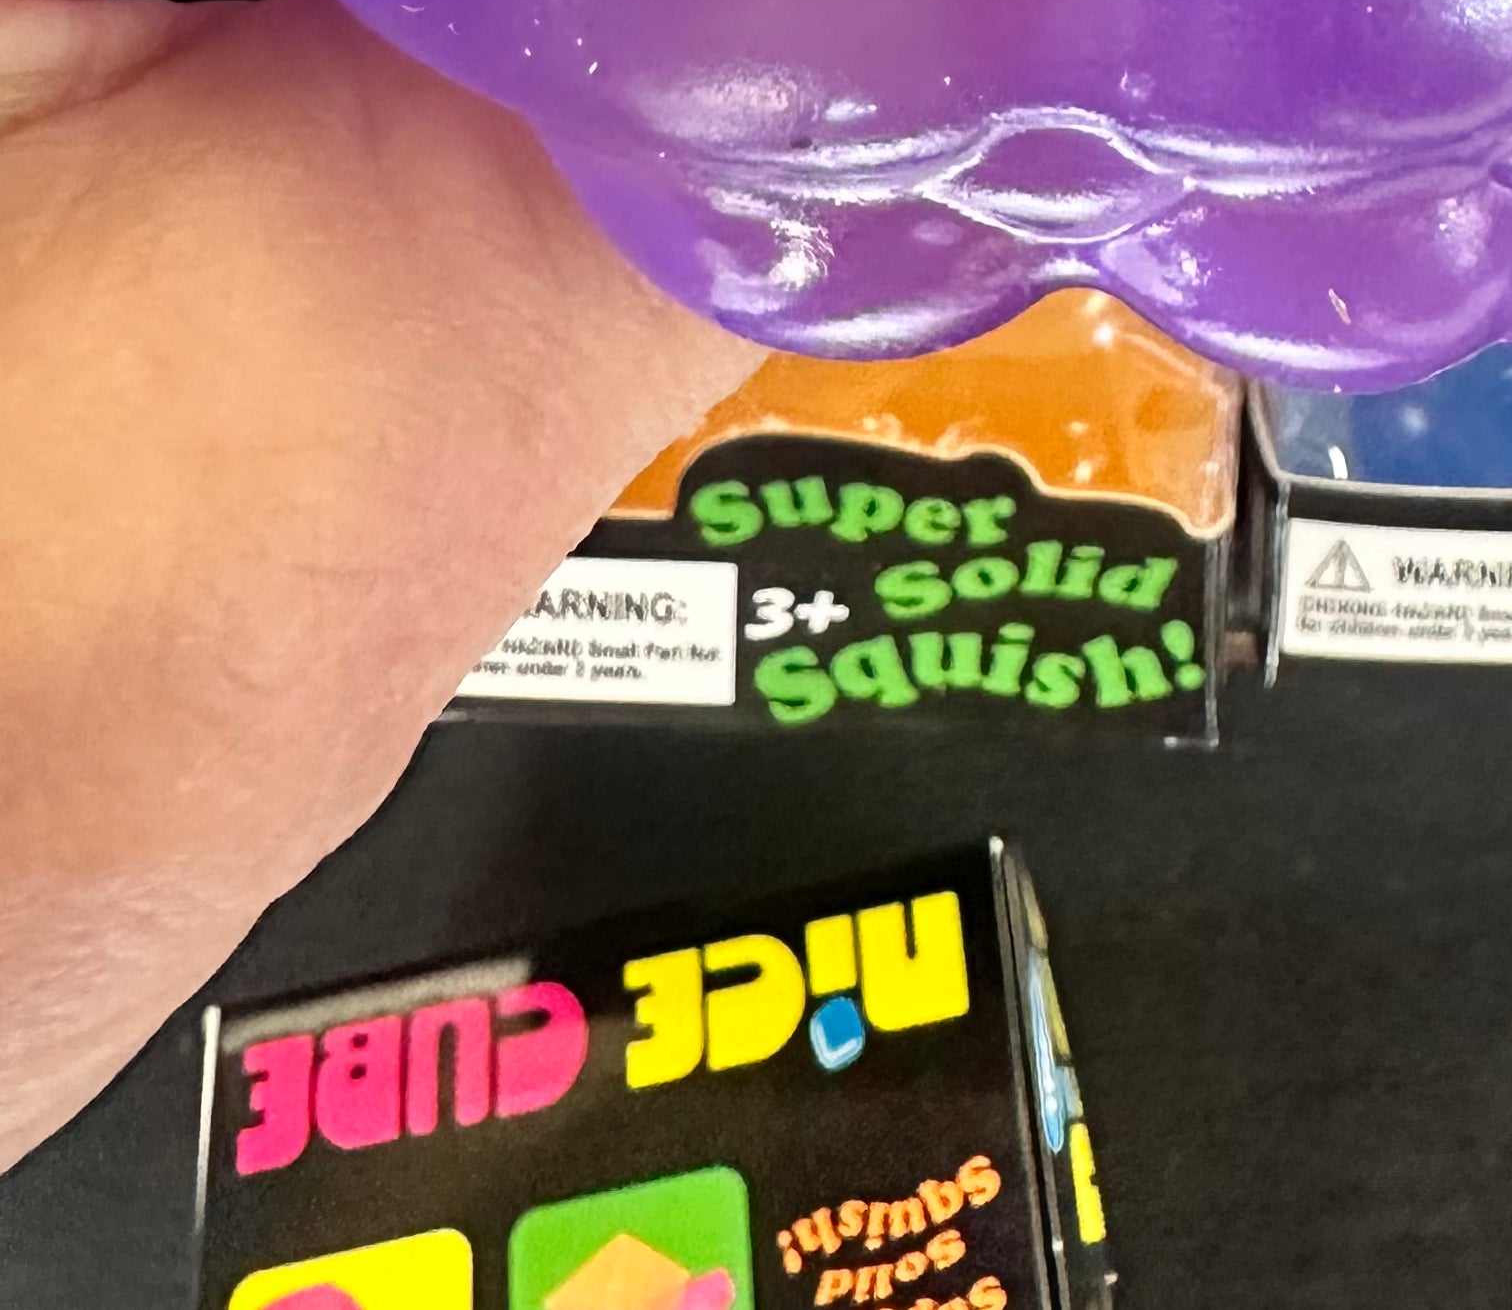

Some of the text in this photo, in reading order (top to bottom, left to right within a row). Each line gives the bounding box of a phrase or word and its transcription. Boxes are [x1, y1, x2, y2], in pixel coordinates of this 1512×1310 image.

[690, 476, 1017, 547] Super
[522, 587, 688, 626] ARNING:
[745, 587, 850, 642] 3+
[874, 540, 1179, 620] Solid
[754, 619, 1207, 725] Squish!
[235, 981, 589, 1176] CUBE
